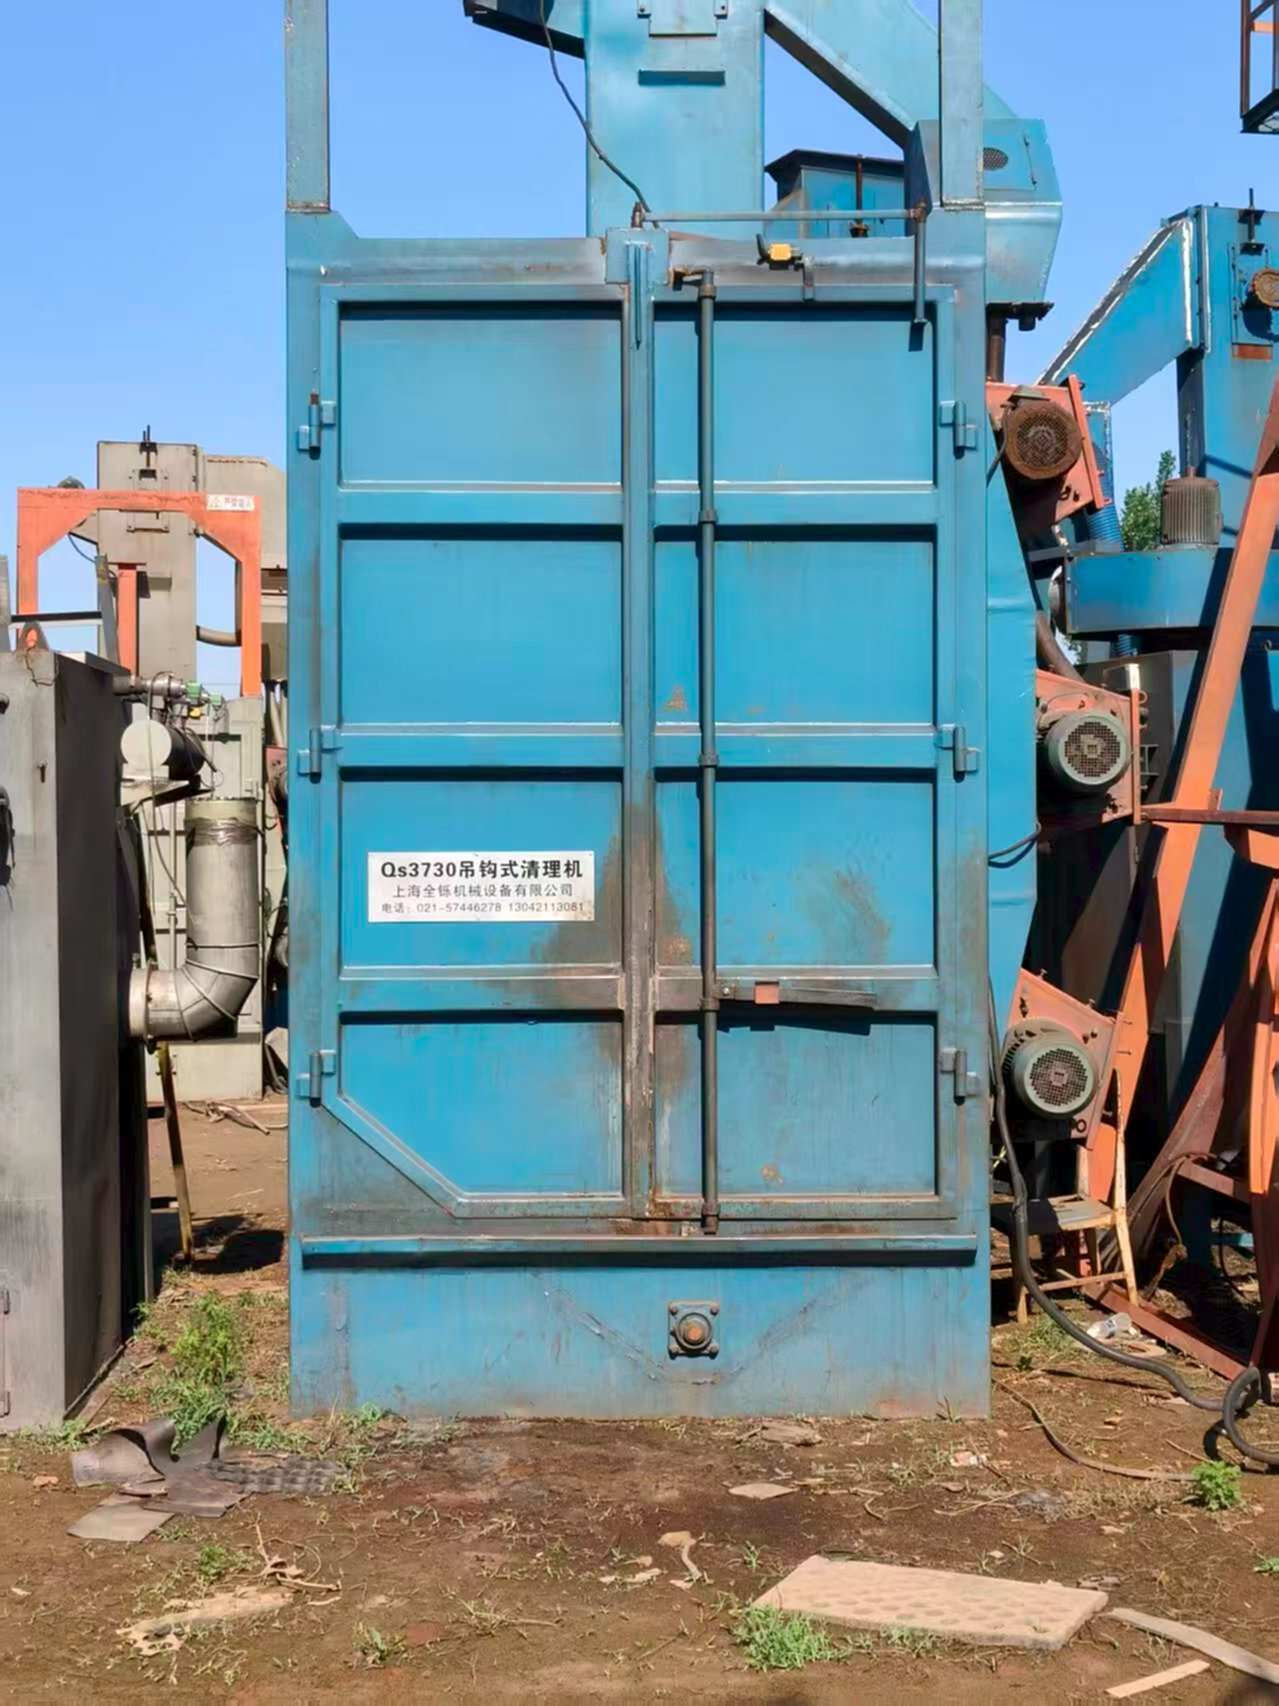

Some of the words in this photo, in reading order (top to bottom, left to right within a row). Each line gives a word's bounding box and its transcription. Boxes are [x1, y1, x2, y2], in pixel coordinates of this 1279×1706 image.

[381, 860, 583, 879] Qs3730吊钩式清理机
[508, 901, 584, 912] 13042113081
